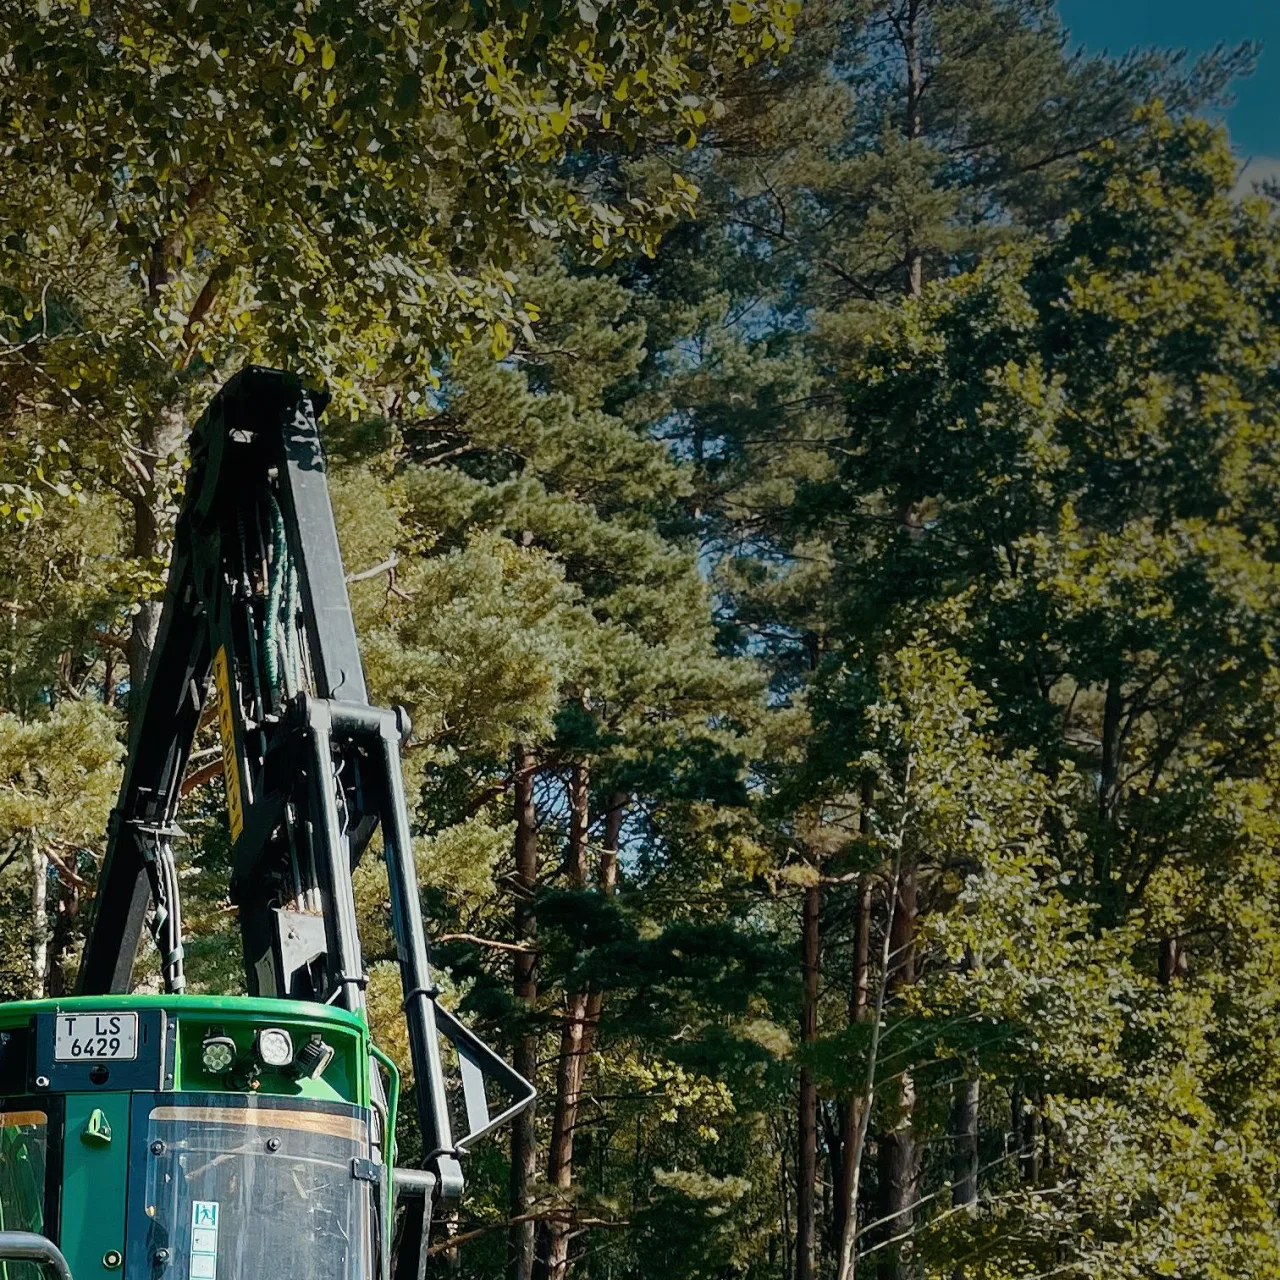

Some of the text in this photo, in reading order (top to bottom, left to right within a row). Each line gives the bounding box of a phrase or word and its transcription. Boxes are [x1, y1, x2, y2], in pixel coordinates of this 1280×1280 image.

[64, 1016, 121, 1036] T LS
[71, 1037, 121, 1057] 6429
